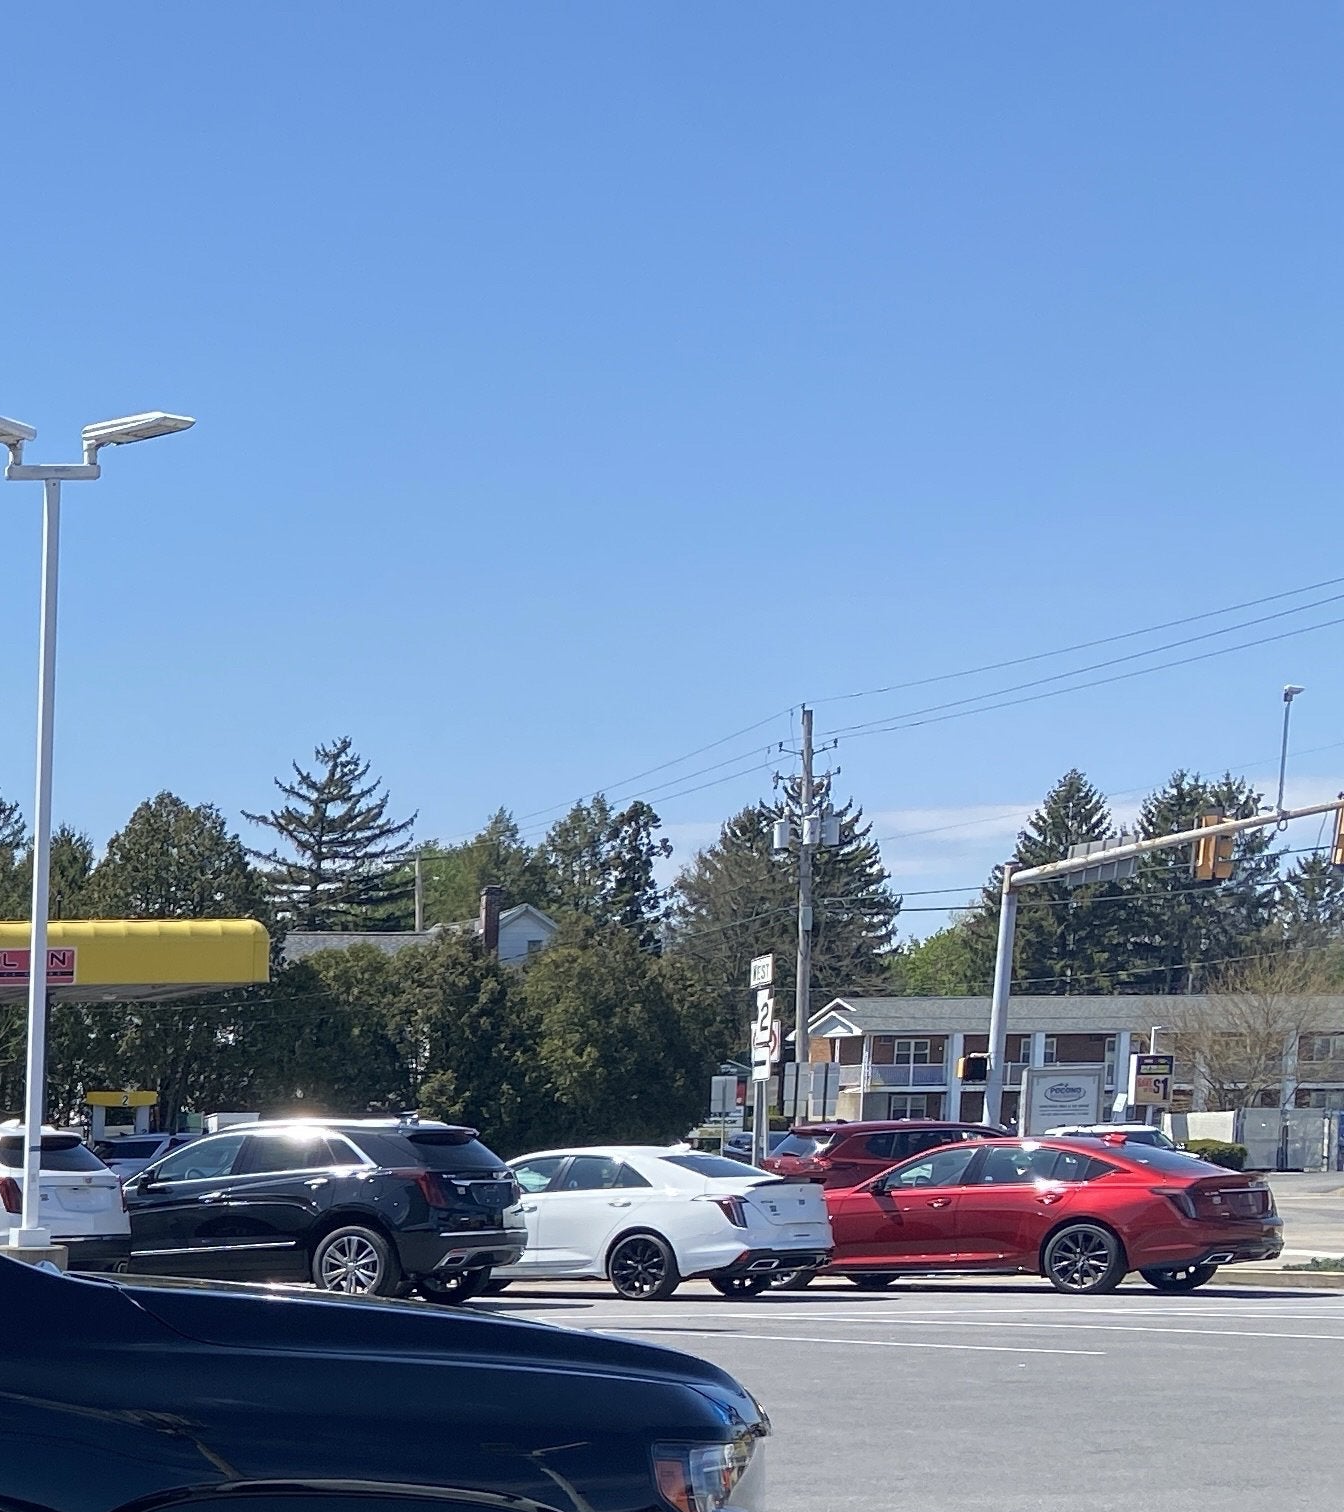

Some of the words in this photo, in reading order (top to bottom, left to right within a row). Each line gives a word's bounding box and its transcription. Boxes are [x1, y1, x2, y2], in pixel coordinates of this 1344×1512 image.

[752, 963, 770, 981] WEST
[760, 1002, 769, 1032] 2
[122, 1095, 129, 1106] 2
